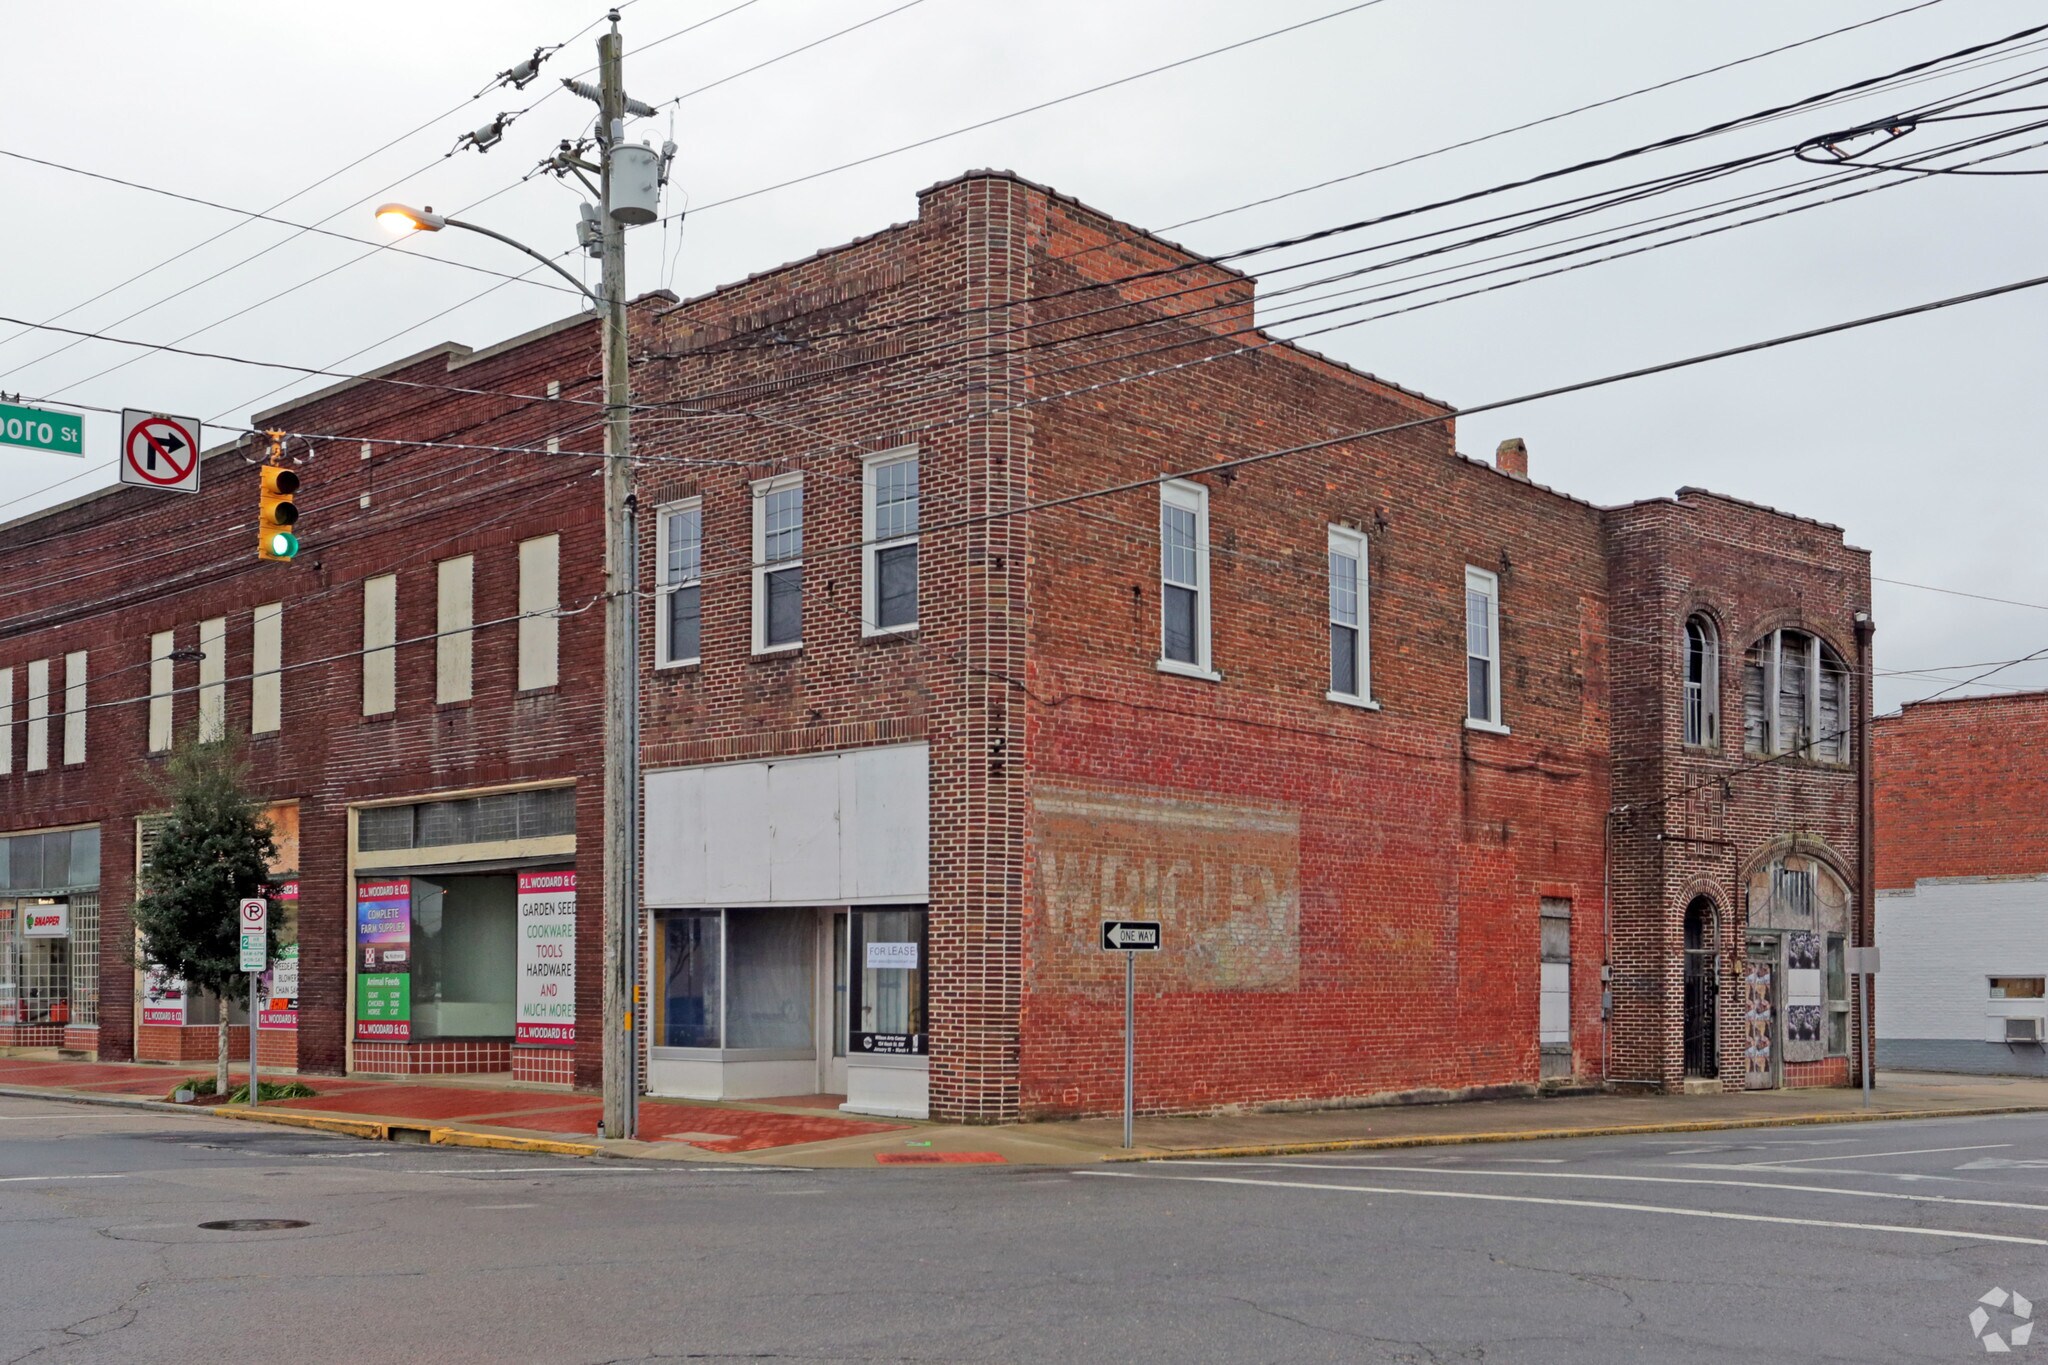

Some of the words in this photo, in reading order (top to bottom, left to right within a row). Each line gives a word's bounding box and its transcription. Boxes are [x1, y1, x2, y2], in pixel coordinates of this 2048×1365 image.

[0, 417, 53, 444] oro
[61, 427, 78, 443] St
[564, 876, 569, 886] &
[395, 885, 399, 894] &
[368, 908, 399, 919] COMPLETE
[523, 903, 555, 916] GARDEN
[34, 916, 60, 926] SNAPPER
[361, 924, 377, 933] FARM
[379, 922, 405, 932] SUPPLIER
[527, 924, 572, 938] COOKWARE
[1120, 931, 1135, 941] ONE
[1138, 931, 1154, 941] WAY
[243, 938, 248, 946] 2
[536, 945, 562, 958] TOOLS
[870, 946, 885, 955] FOR
[888, 946, 915, 955] LEASE
[527, 963, 571, 977] HARDWARE
[367, 977, 384, 986] Animal
[385, 977, 400, 986] Feeds
[276, 986, 289, 995] CHAIN
[541, 984, 558, 996] AND
[271, 1000, 287, 1010] ECHO
[523, 1004, 546, 1017] MUCH
[394, 1025, 399, 1034] &
[562, 1029, 567, 1039] &
